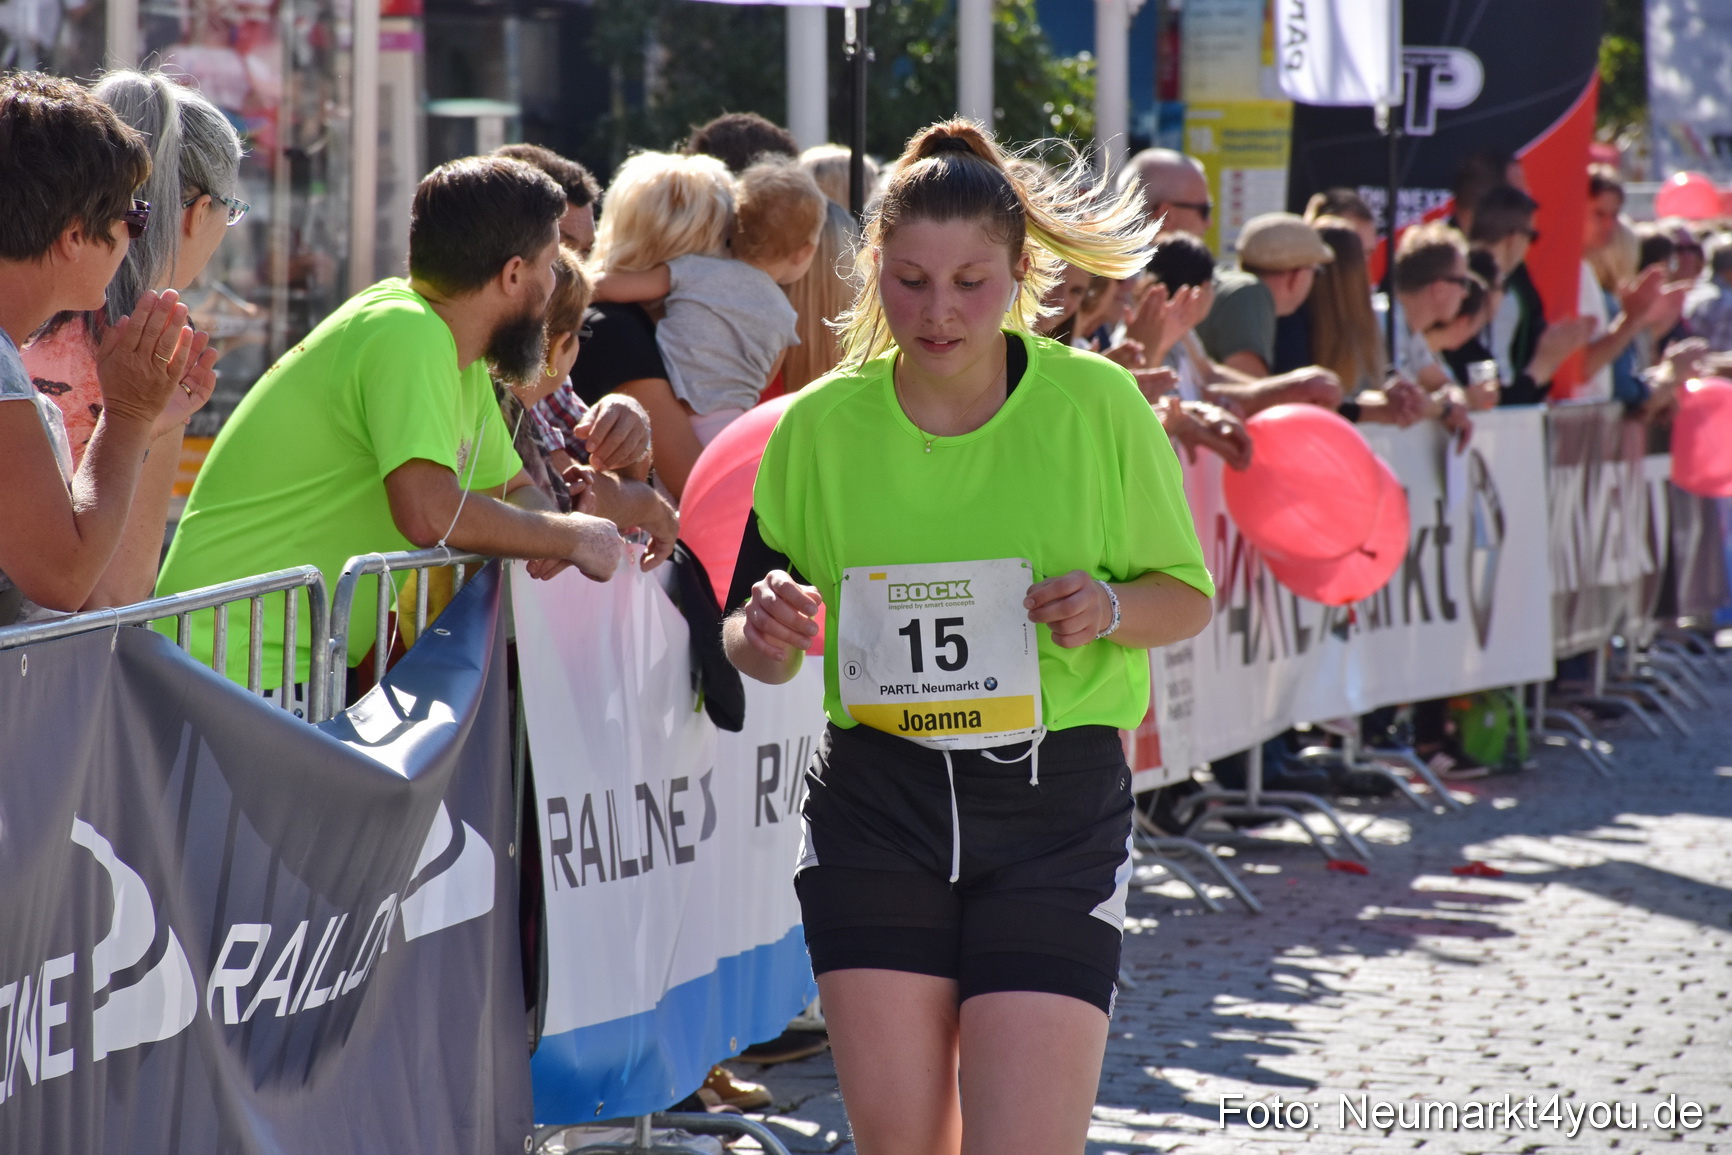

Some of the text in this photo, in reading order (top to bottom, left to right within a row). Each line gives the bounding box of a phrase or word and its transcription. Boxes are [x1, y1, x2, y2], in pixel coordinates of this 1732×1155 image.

[888, 580, 974, 602] BOCK
[888, 600, 976, 611] inspired by smart concepts
[898, 616, 969, 673] 15
[880, 683, 919, 696] PARTL
[922, 680, 980, 694] Neumarkt
[898, 709, 982, 732] Joanna
